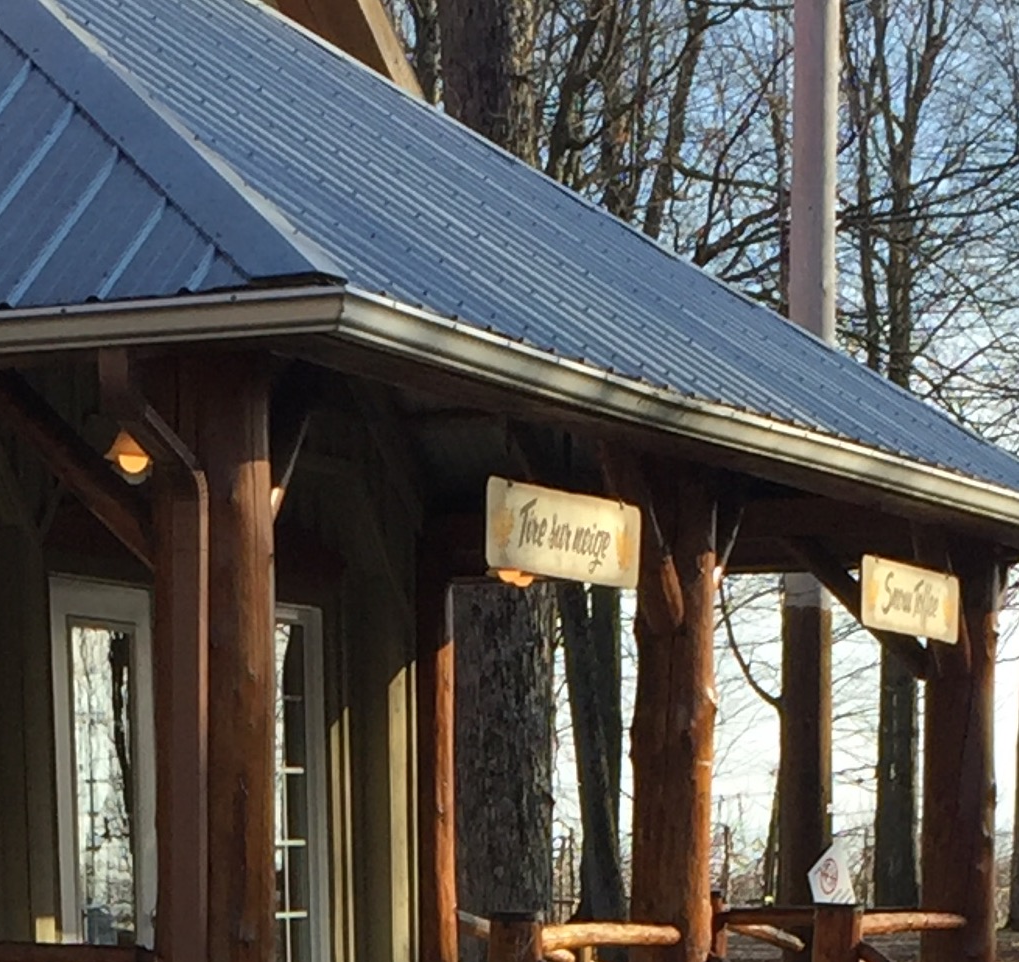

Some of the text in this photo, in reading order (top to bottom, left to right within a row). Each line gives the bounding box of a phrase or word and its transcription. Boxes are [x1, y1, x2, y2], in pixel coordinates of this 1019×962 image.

[518, 498, 611, 574] Tire sur neige
